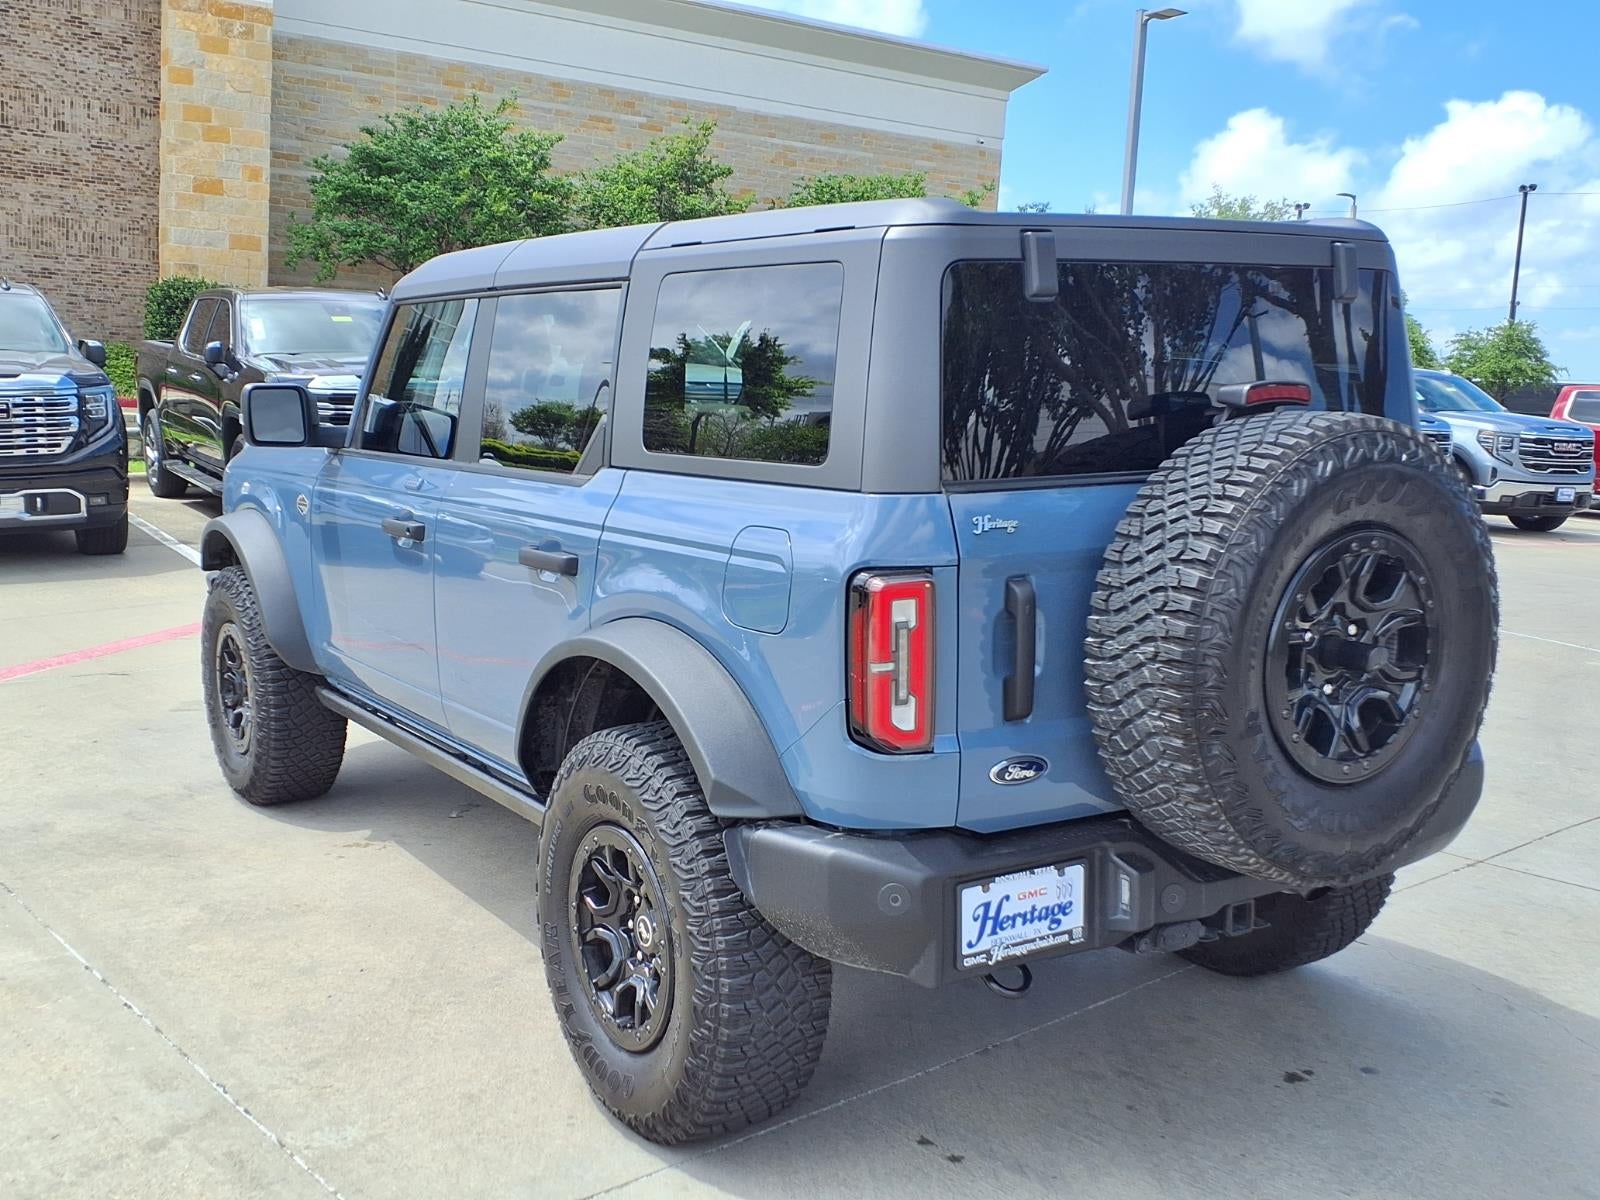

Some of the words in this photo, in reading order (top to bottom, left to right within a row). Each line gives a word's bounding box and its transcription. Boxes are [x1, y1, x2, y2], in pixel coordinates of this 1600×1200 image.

[972, 514, 1019, 535] Heritage
[1004, 764, 1036, 780] Ford
[1018, 888, 1047, 900] GMC
[966, 894, 1073, 948] Heritage
[963, 954, 988, 967] GMC
